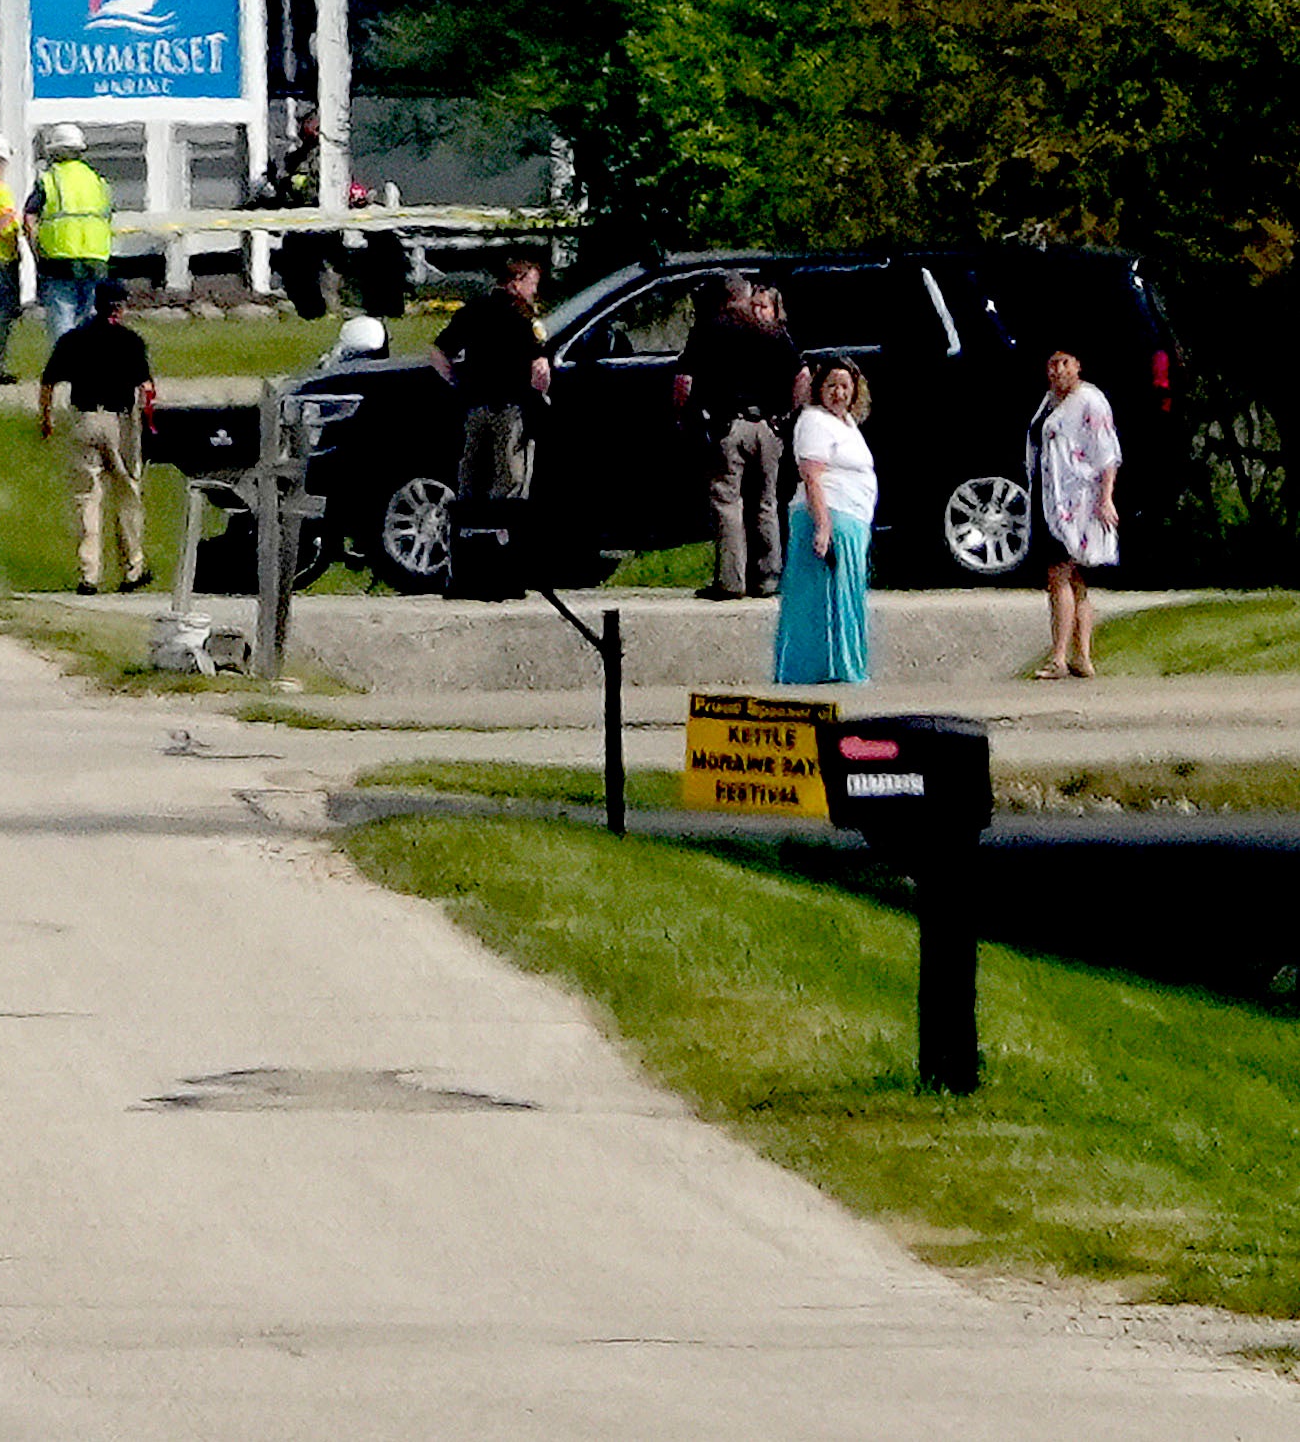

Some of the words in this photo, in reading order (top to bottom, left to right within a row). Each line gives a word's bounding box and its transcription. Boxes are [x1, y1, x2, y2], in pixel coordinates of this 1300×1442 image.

[34, 32, 228, 76] SUMMERSET
[93, 77, 174, 95] MARINE
[728, 724, 797, 749] KETTLE
[692, 750, 775, 773] MORAINE
[782, 755, 817, 778] DAY
[715, 778, 800, 806] FESTIVAL
